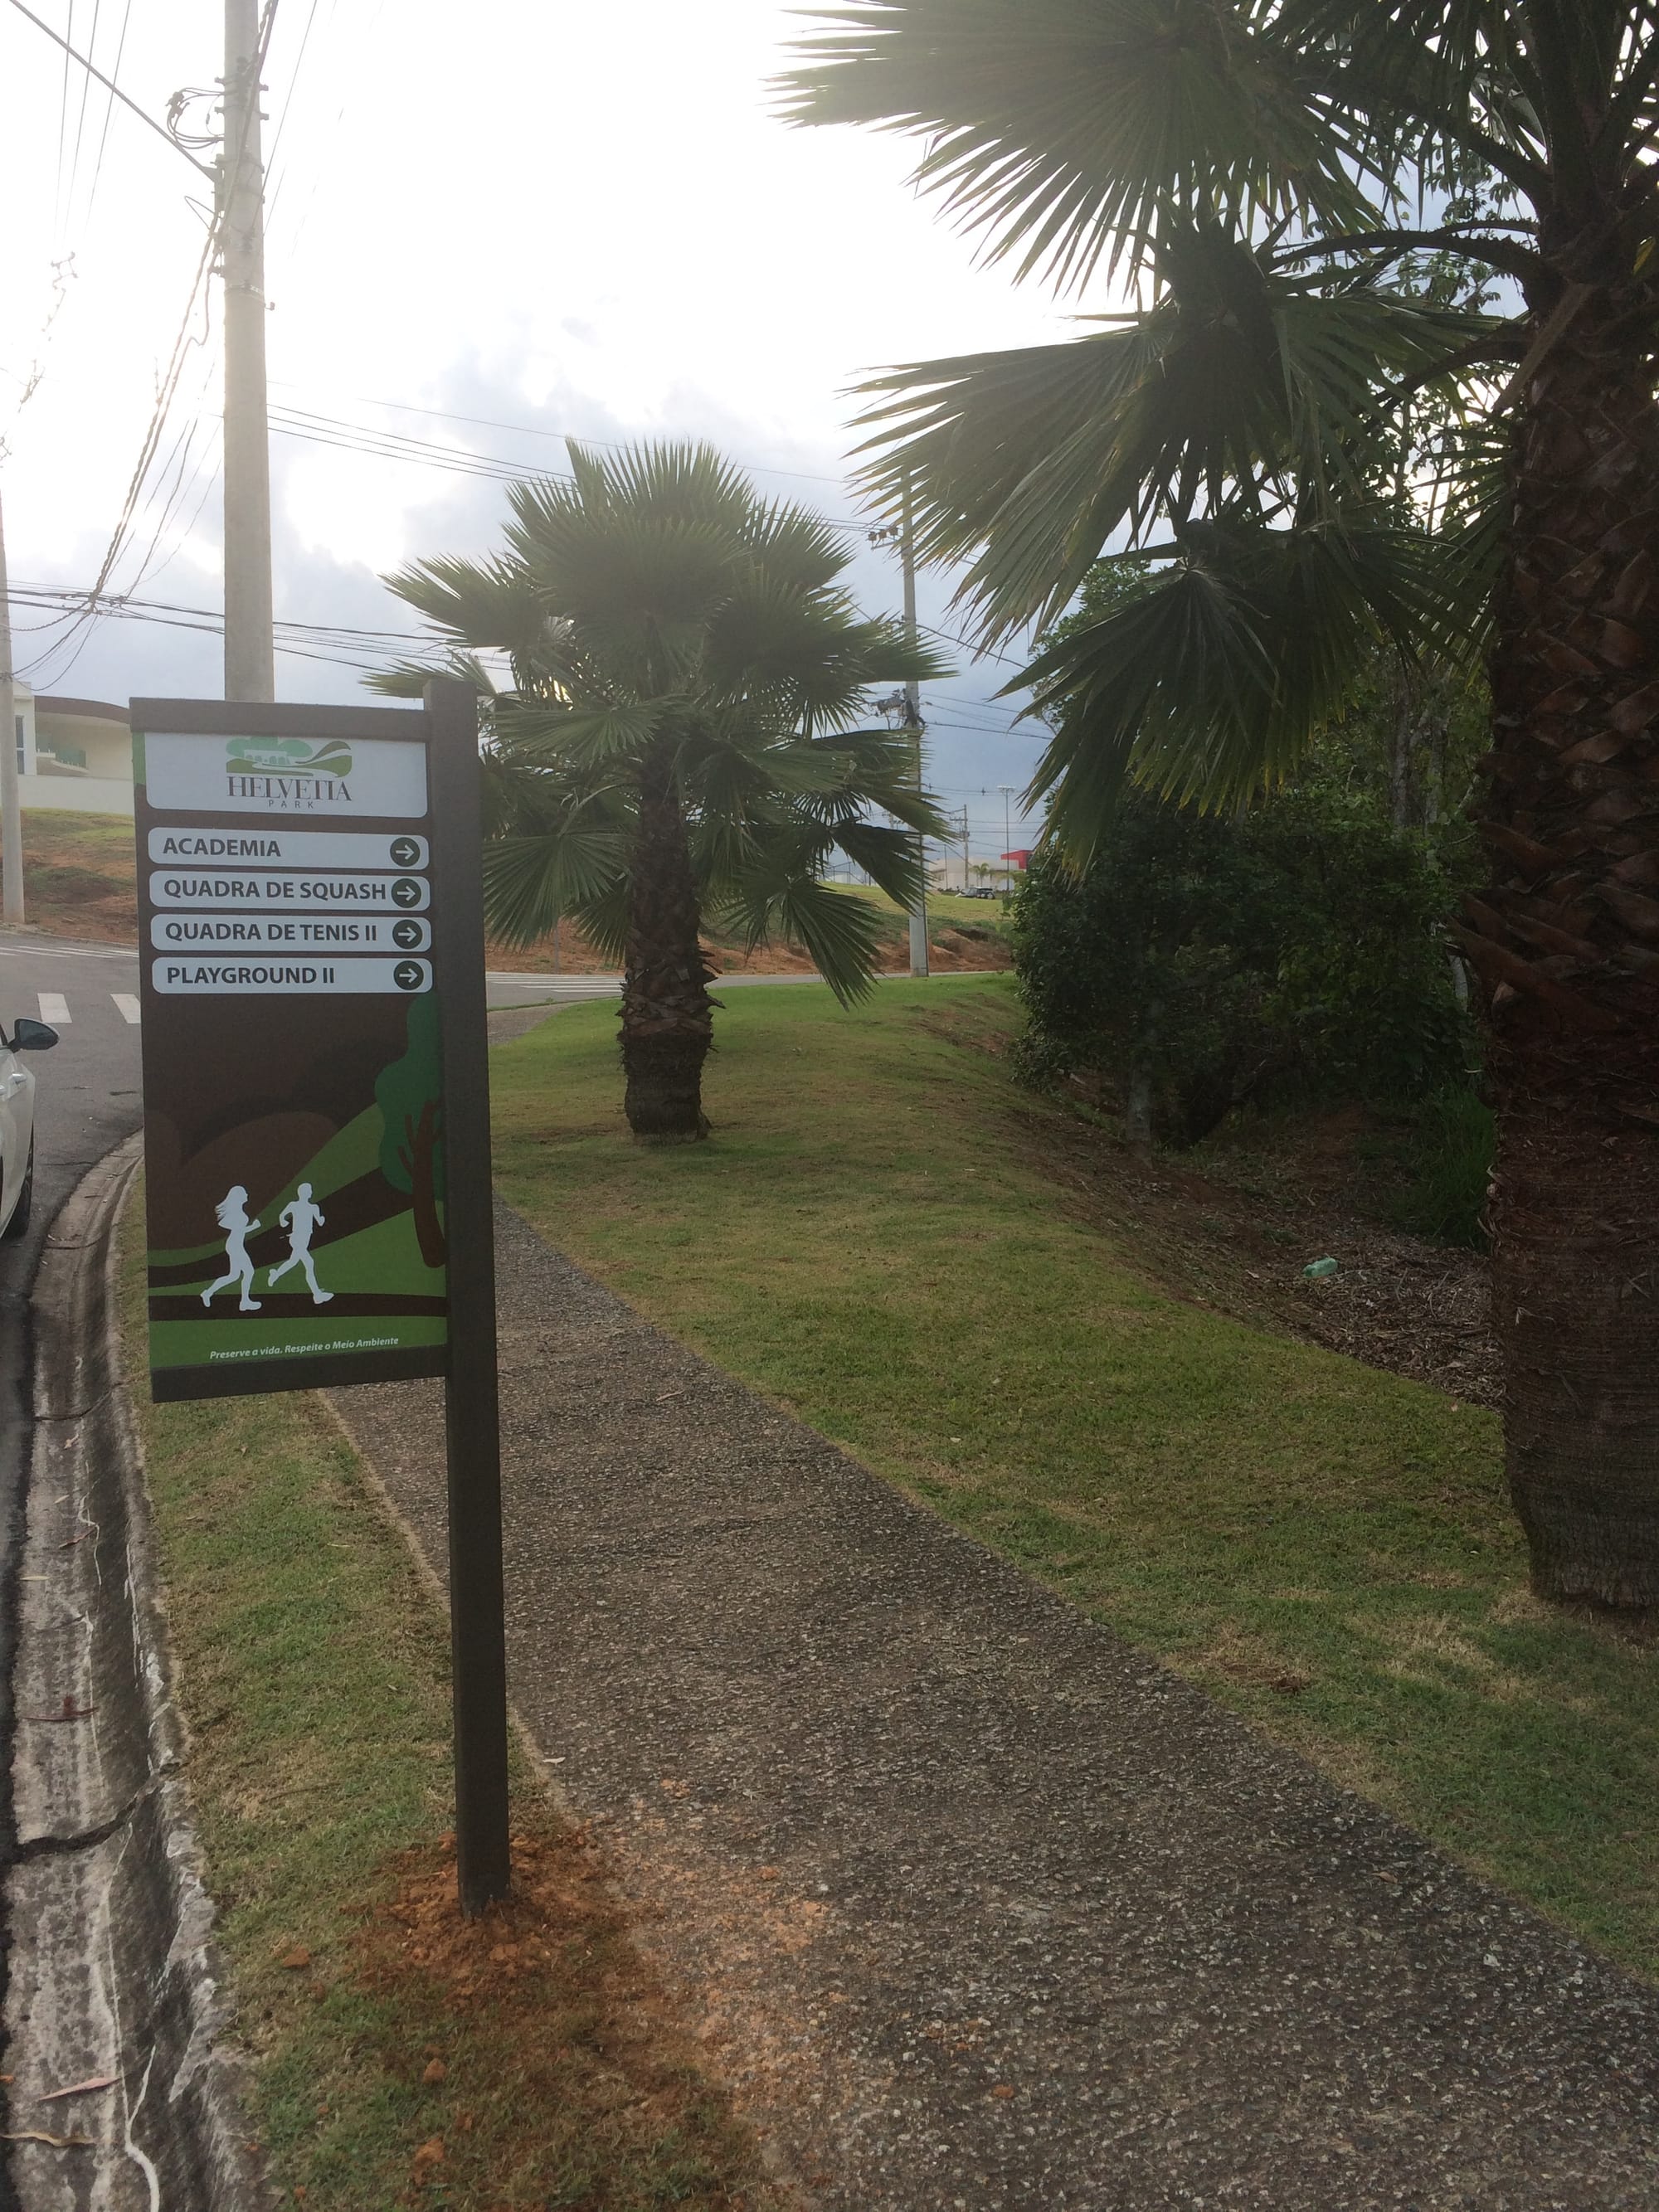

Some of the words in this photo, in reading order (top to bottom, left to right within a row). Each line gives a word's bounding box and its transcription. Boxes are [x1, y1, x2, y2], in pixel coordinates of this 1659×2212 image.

[226, 776, 352, 801] HELVETIA
[268, 799, 314, 809] PARK
[163, 837, 282, 857] ACADEMIA
[163, 878, 260, 898] QUADRA
[266, 881, 294, 898] DE
[299, 882, 387, 902] SQUASH
[165, 922, 262, 941] QUADRA
[268, 924, 296, 941] DE
[300, 924, 359, 941] TENIS
[365, 925, 377, 941] II
[167, 967, 317, 984] PLAYGROUND
[323, 966, 335, 984] II
[209, 1349, 251, 1359] Preserve
[260, 1345, 284, 1355] vida.
[285, 1343, 324, 1354] Respeite
[324, 1343, 331, 1351] o
[332, 1339, 355, 1349] Meio
[356, 1337, 399, 1348] Ambiente
